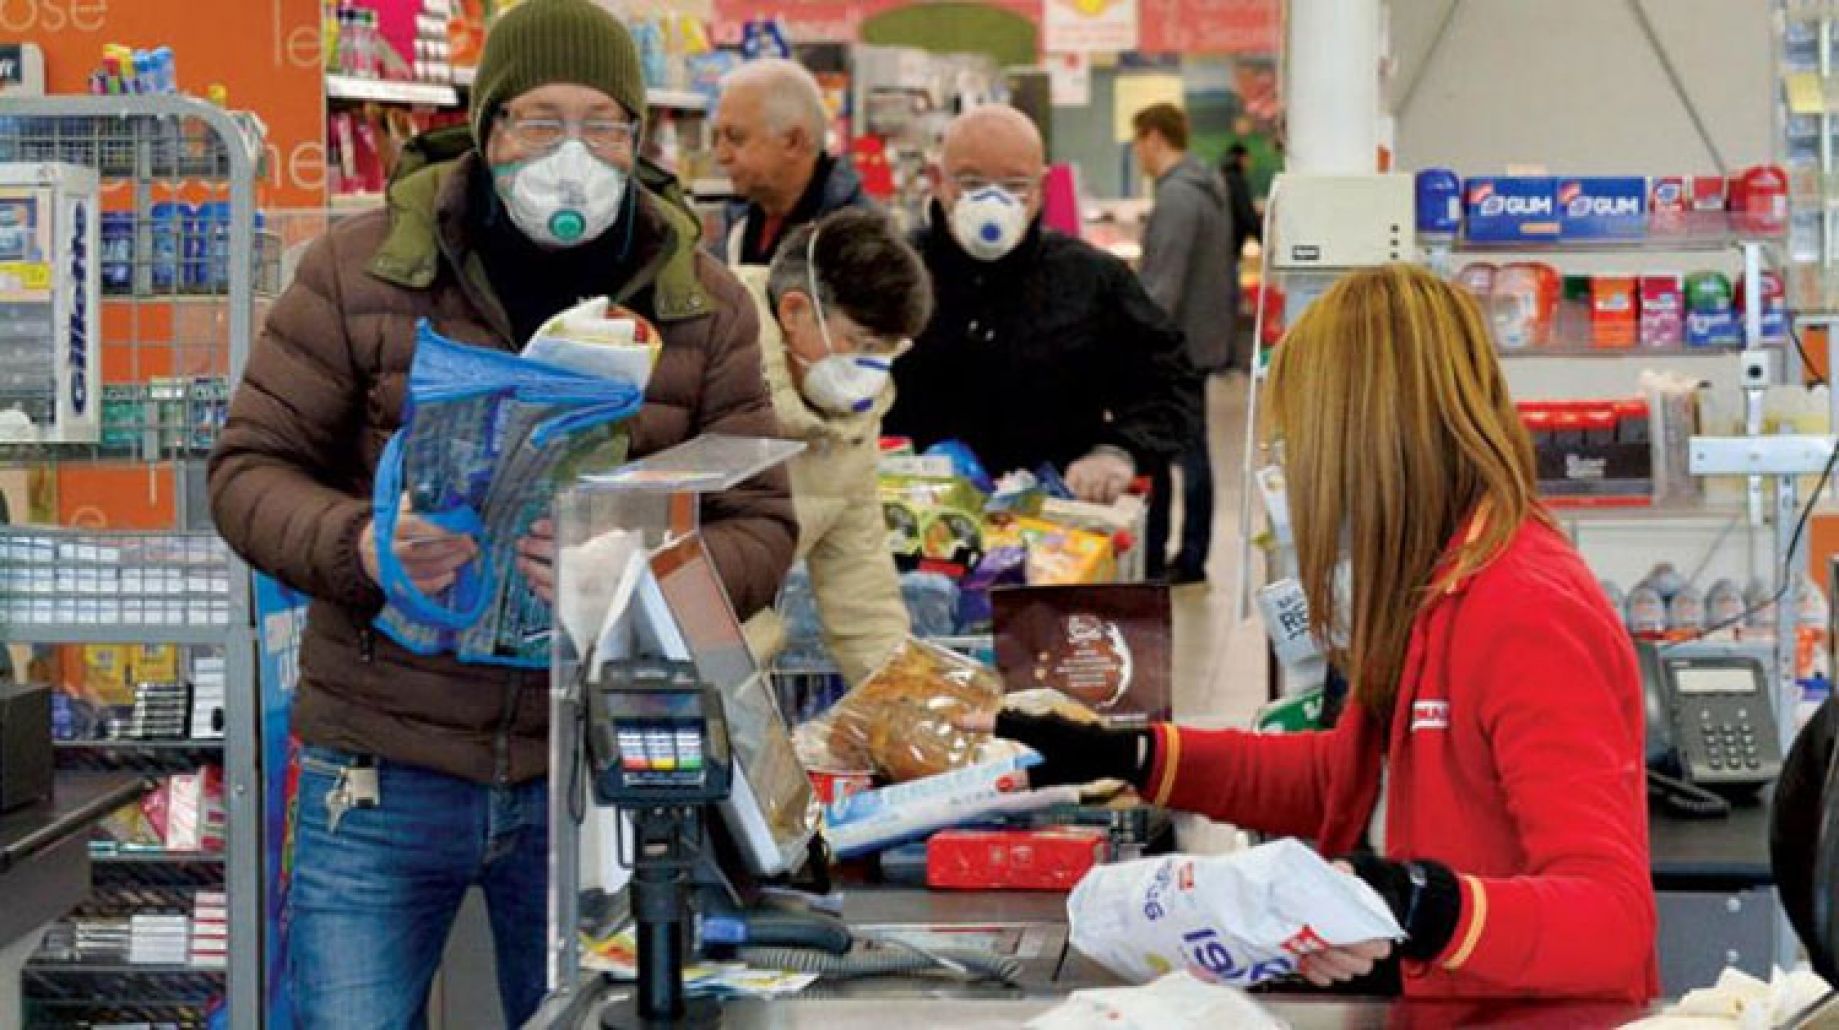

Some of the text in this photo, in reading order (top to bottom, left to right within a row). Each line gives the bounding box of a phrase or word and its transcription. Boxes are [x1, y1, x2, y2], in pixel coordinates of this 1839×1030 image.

[1507, 196, 1552, 215] GUM
[1594, 196, 1639, 215] GUM
[70, 200, 88, 416] Gillette
